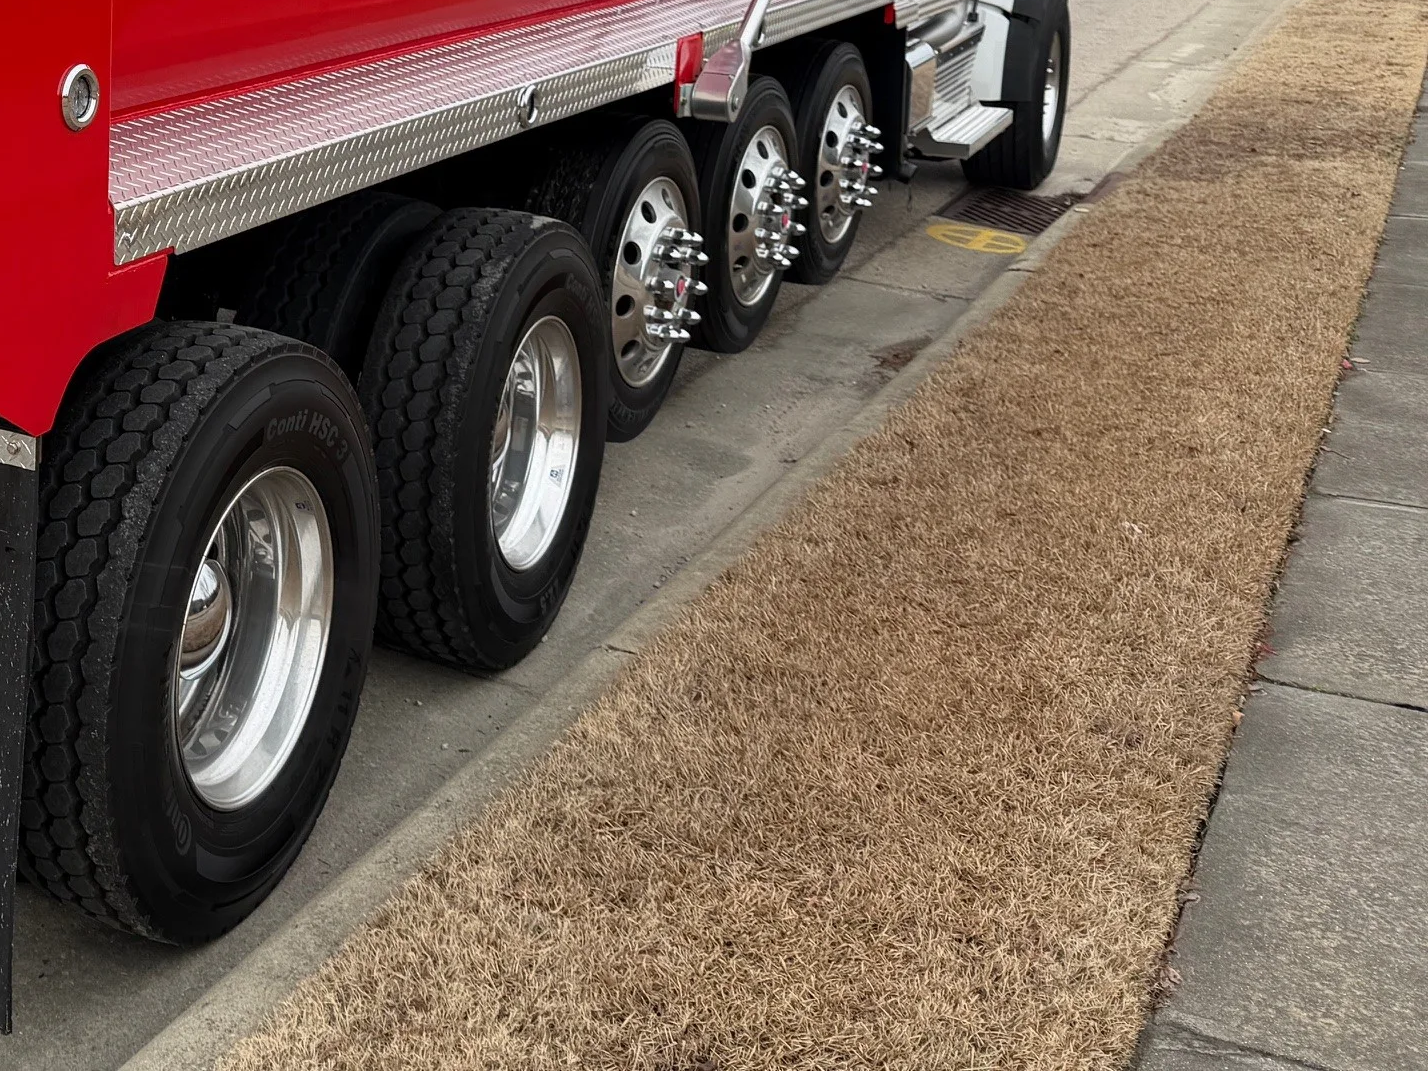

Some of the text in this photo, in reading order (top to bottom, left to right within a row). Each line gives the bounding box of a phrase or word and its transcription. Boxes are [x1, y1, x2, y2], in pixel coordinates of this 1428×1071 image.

[267, 409, 348, 460] Conti HSC 3
